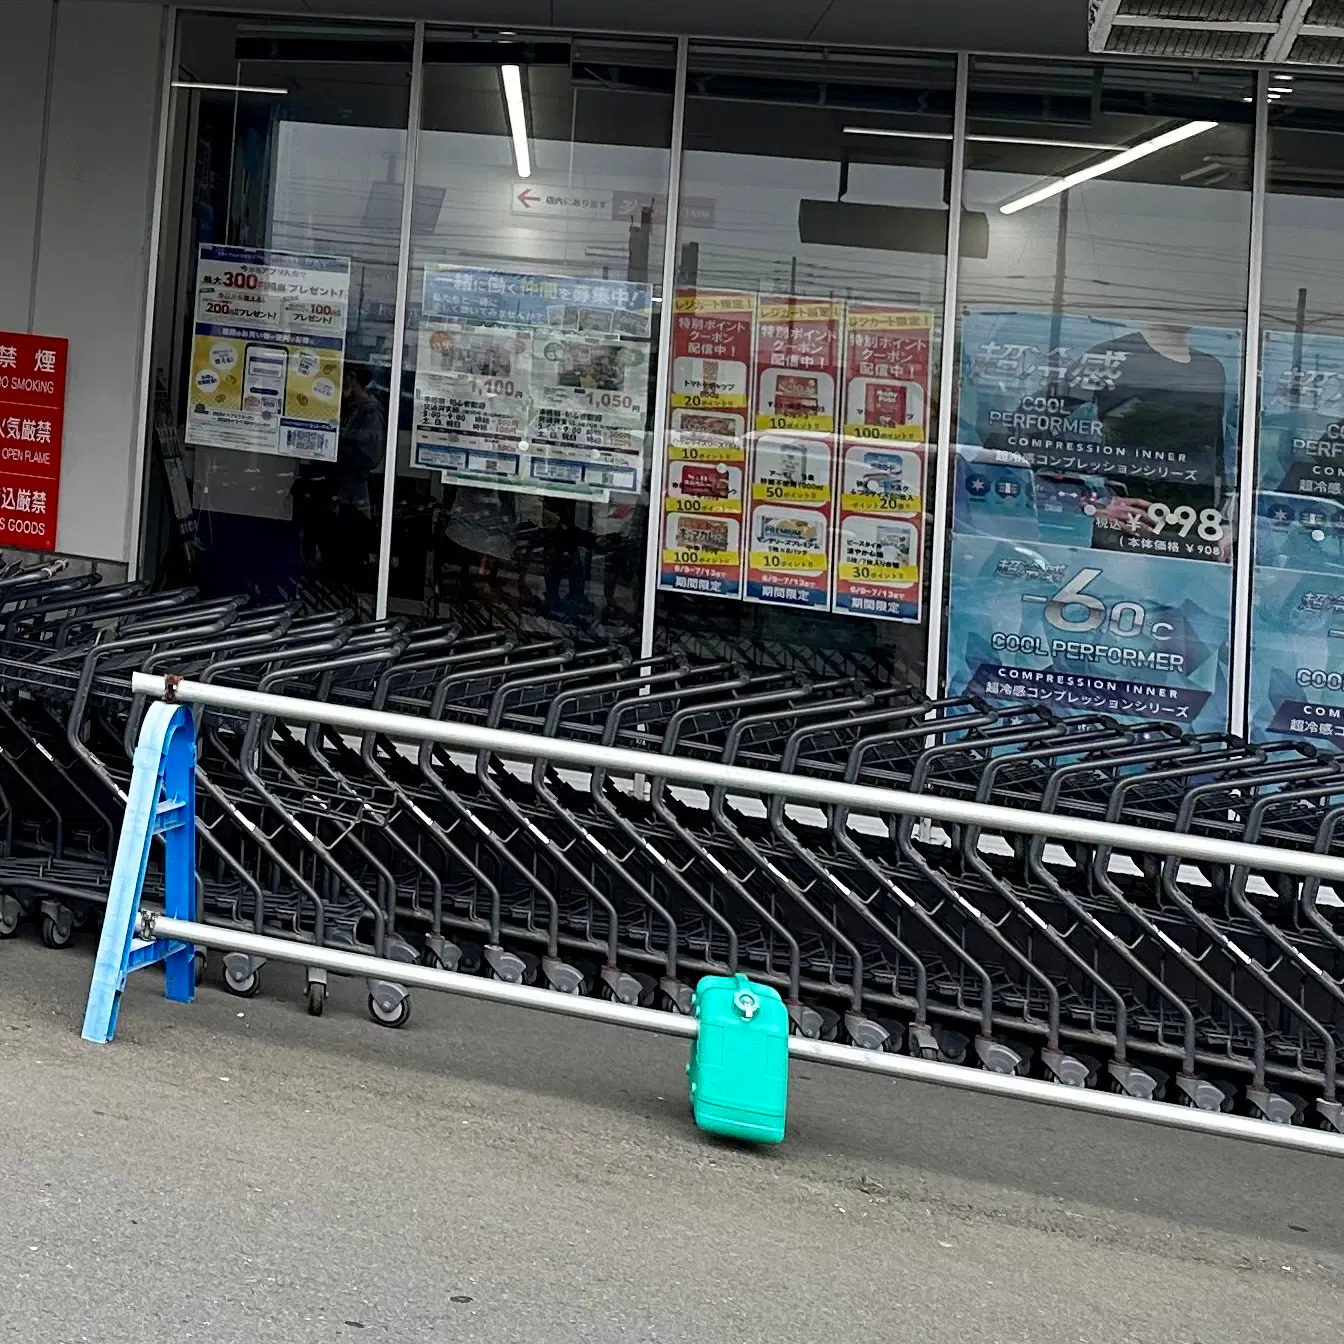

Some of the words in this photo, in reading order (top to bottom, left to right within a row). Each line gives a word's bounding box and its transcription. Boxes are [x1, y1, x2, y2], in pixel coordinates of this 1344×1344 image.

[678, 318, 746, 333] 特別ポイント
[760, 325, 838, 342] 特別ポイント
[689, 330, 734, 344] クーポン
[849, 333, 927, 352] 特別ポイント
[687, 344, 736, 357] 配信中！
[773, 339, 823, 354] クーポン
[34, 349, 56, 373] 煙
[771, 353, 825, 369] 配信中！
[861, 349, 913, 363] クーポン
[859, 362, 915, 378] 配信中！
[971, 341, 1131, 391] 超冷感
[10, 377, 55, 394] SMOKING
[1021, 396, 1070, 415] COOL
[988, 410, 1104, 436] PERFORMER
[2, 447, 23, 462] OPEN
[24, 450, 50, 465] FLAME
[1007, 436, 1126, 456] COMPRESSION
[1135, 450, 1187, 462] INNER
[995, 450, 1198, 481] 超冷感コンプレッションシリーズ
[7, 517, 46, 536] GOODS
[1096, 517, 1122, 531] 税込
[675, 575, 722, 593] 期間限定
[762, 586, 810, 602] 期間限定
[851, 597, 900, 614] 期間限定
[991, 631, 1050, 656] COOL
[1051, 640, 1185, 672] PERFORMER
[997, 668, 1117, 691] COMPRESSION
[1126, 684, 1179, 699] INNER
[985, 681, 1190, 719] 超冷感コンプレッションシリーズ
[1303, 705, 1341, 718] COM
